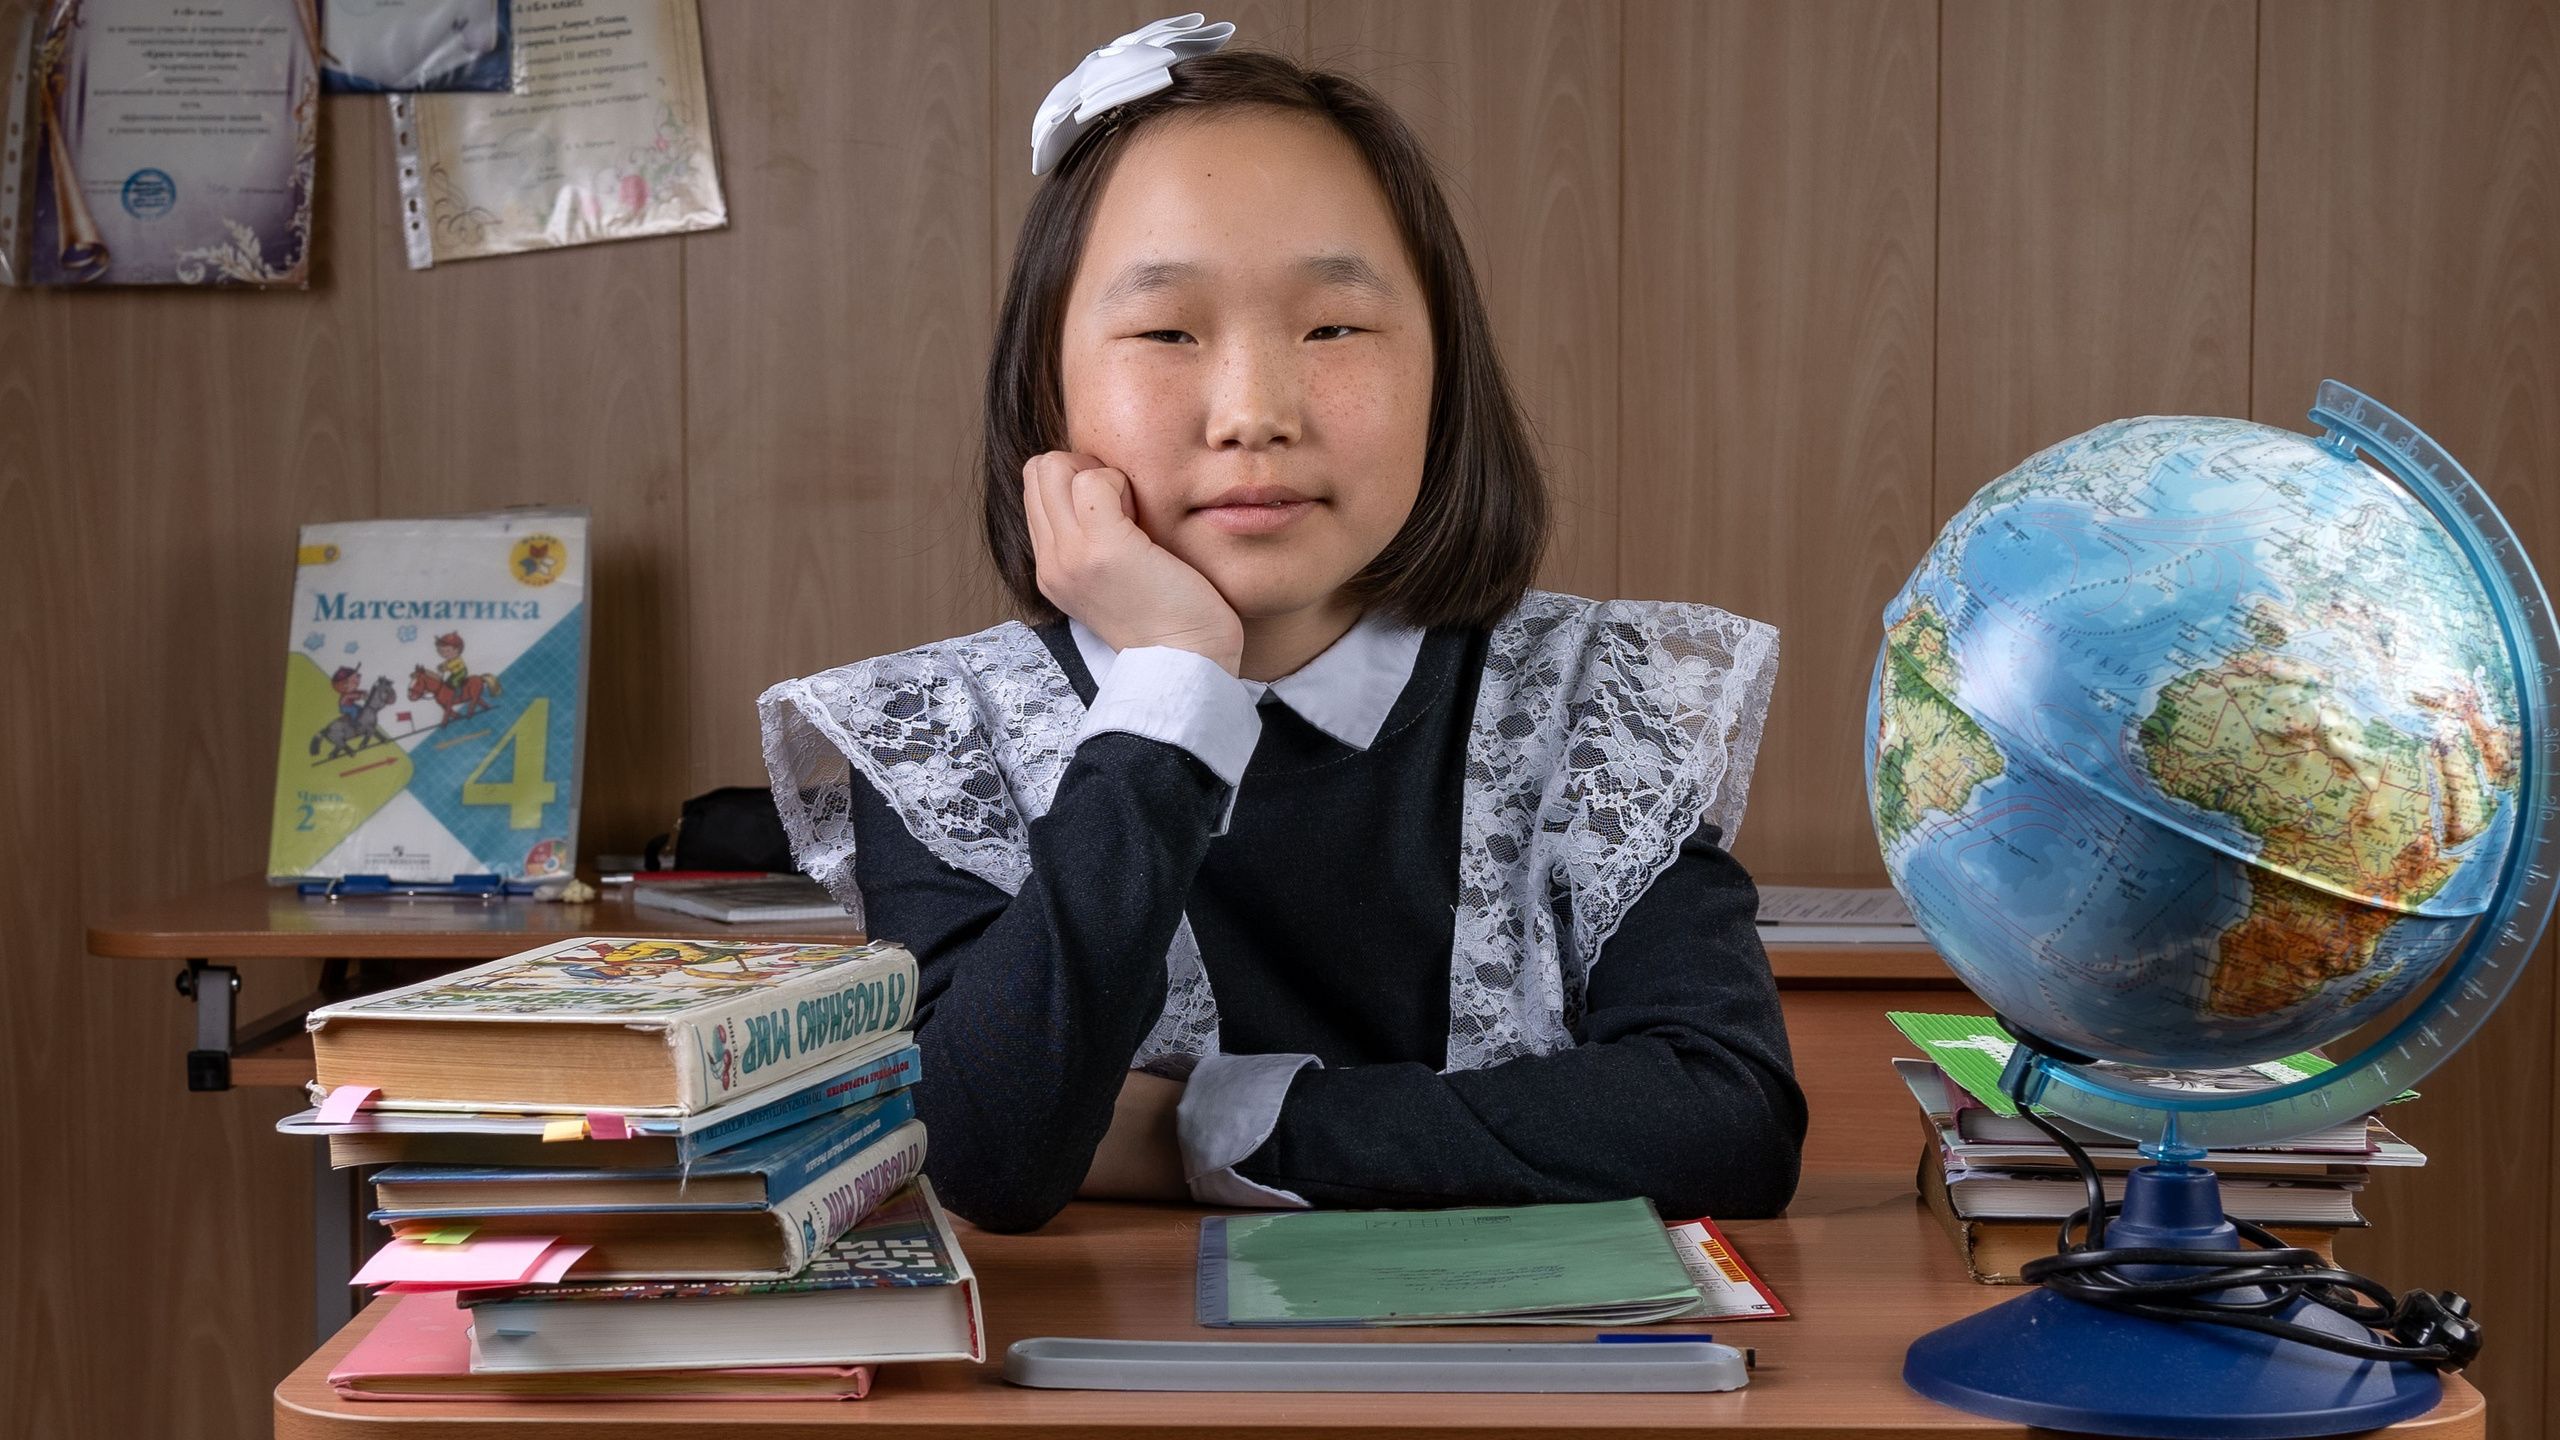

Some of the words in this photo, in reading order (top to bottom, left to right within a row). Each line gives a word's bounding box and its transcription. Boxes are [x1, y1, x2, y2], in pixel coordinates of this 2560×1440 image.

[313, 593, 541, 622] Математика
[462, 697, 557, 830] 4
[296, 790, 344, 803] Часть
[295, 804, 317, 832] 2
[797, 981, 885, 1054] ПОЗНАЮ
[882, 973, 905, 1031] Я
[726, 1017, 737, 1088] РАСТЕНИЯ
[742, 1008, 791, 1075] МИР
[826, 1072, 870, 1098] РАЗРАБОТКИ
[746, 1093, 812, 1127] ИЗОБРАЗИТЕЛЬНОМУ
[705, 1117, 745, 1142] ИСКУССТВУ
[822, 1184, 855, 1245] МИР
[835, 1239, 929, 1250] ПИ
[517, 1285, 646, 1294] КАРАШЕВА
